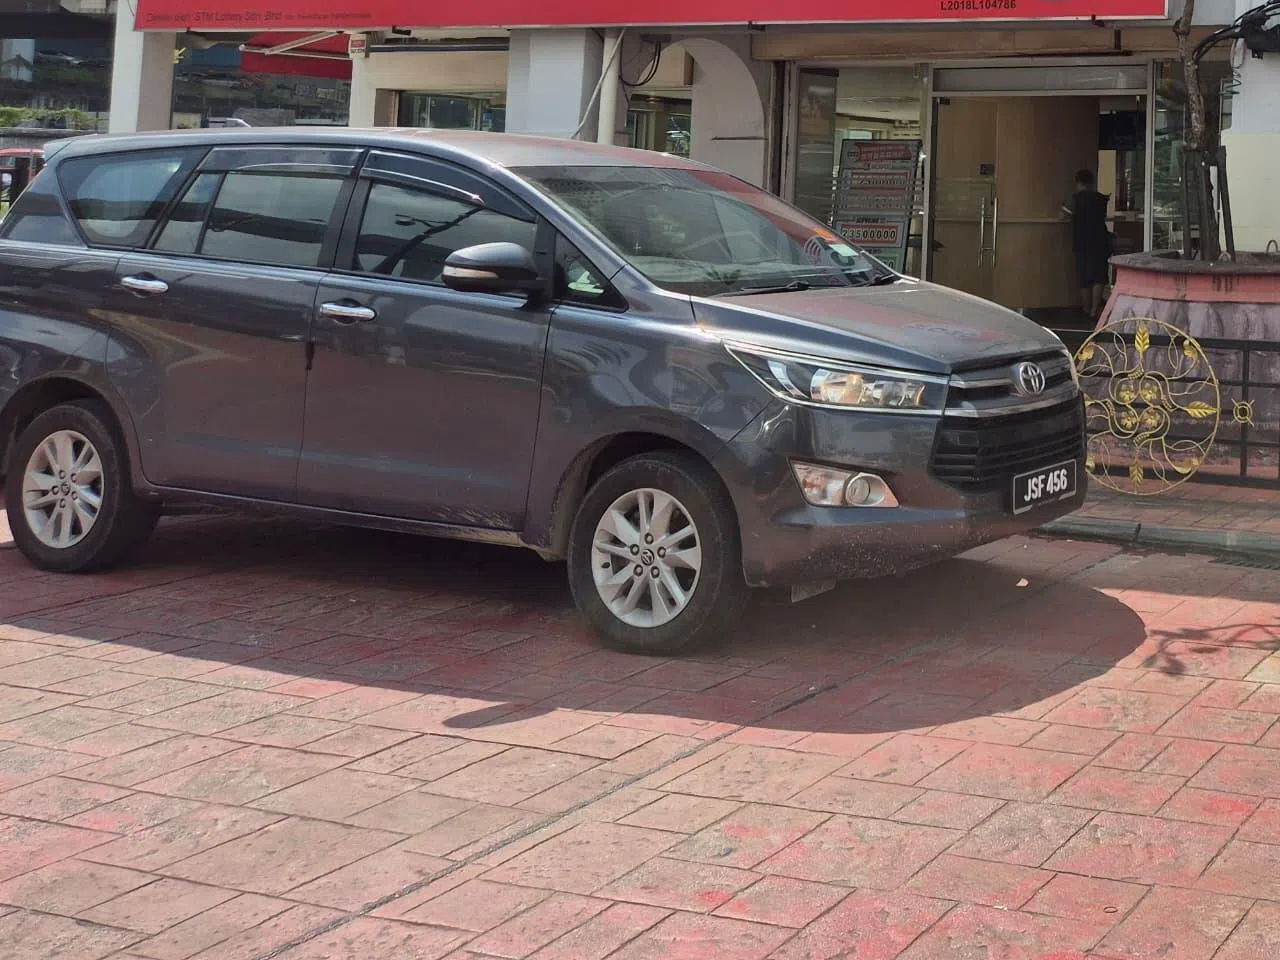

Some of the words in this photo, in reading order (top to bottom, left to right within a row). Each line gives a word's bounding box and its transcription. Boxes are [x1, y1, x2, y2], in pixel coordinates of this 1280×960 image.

[940, 0, 1017, 11] L2018L104786
[1023, 474, 1046, 502] JSF
[1046, 468, 1068, 494] 456
